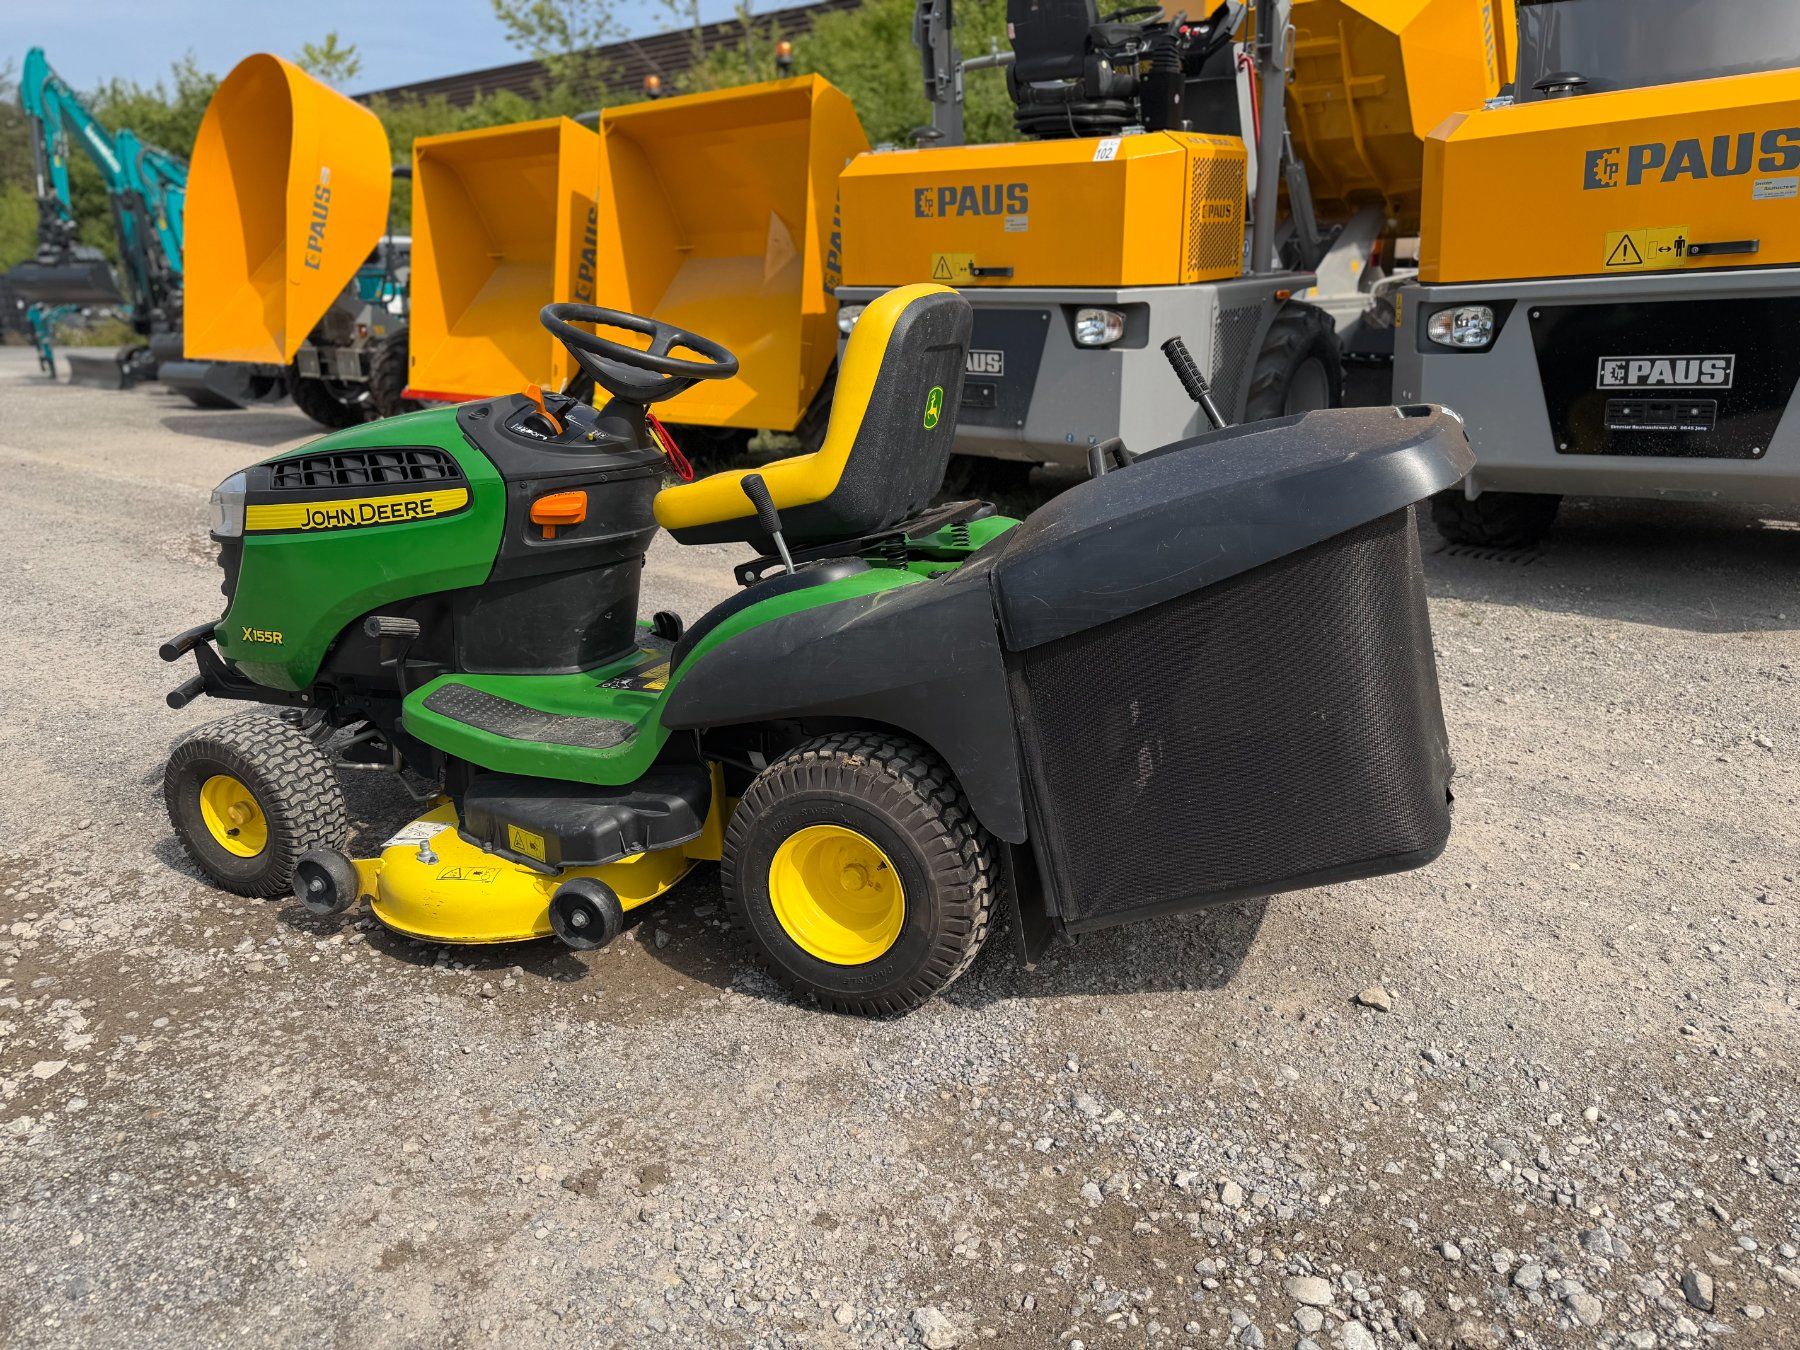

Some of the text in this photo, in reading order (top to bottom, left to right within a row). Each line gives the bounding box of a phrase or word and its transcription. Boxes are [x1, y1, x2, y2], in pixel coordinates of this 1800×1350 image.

[1626, 127, 1800, 186] PAUS
[937, 182, 1029, 218] PAUS
[1208, 203, 1232, 219] PAUS
[306, 184, 331, 254] PAUS
[966, 352, 1000, 373] AUS
[1627, 359, 1726, 385] PAUS
[301, 498, 435, 528] JOHN DEERE
[241, 626, 284, 645] X155R
